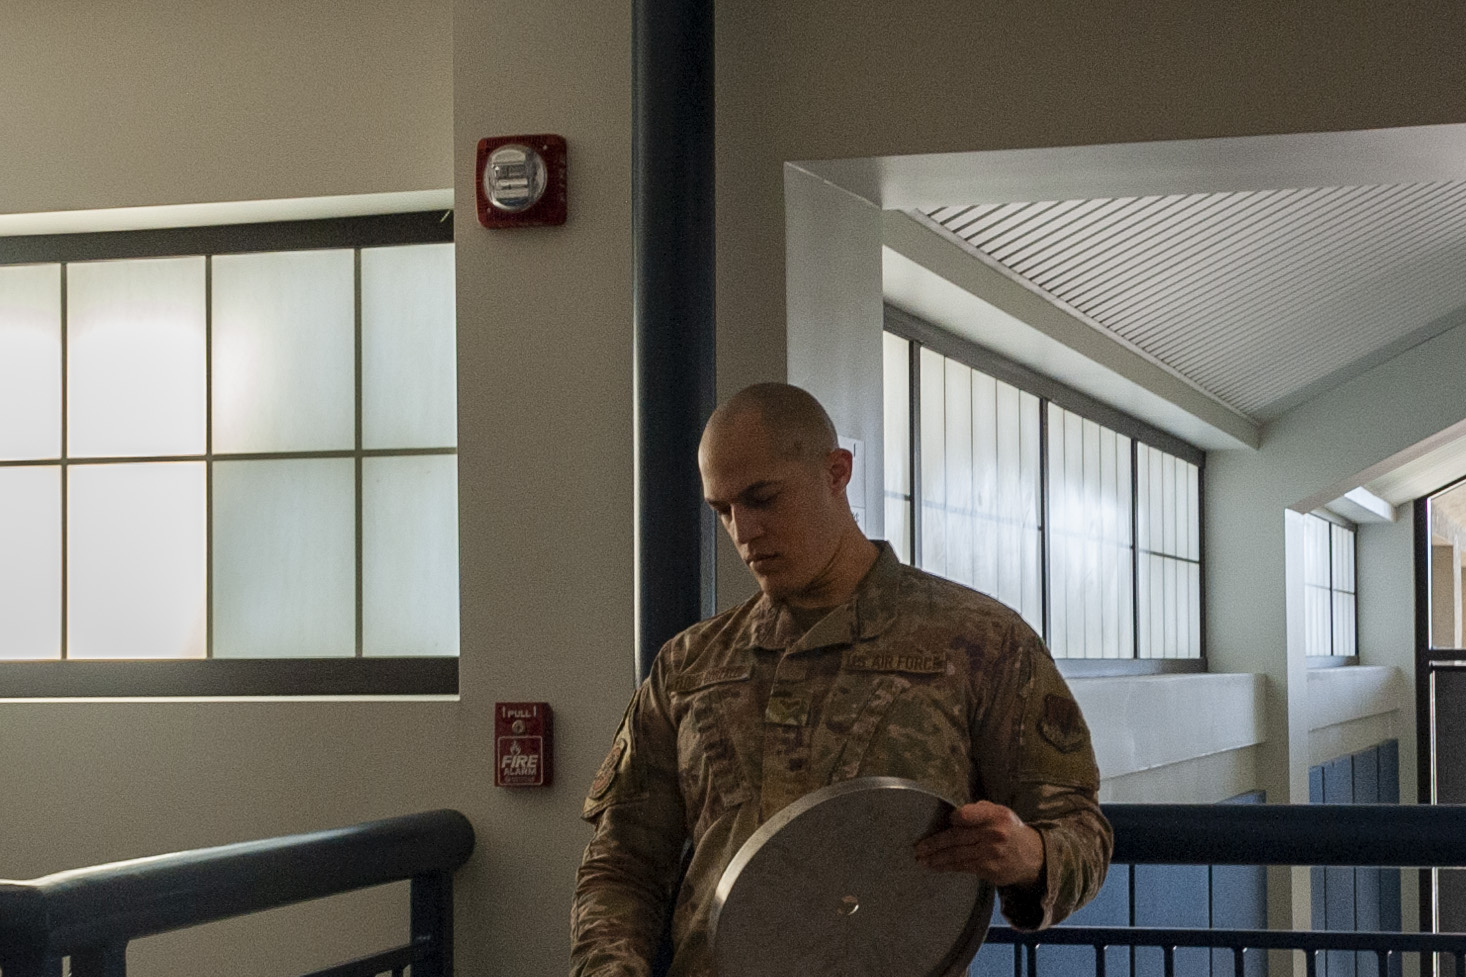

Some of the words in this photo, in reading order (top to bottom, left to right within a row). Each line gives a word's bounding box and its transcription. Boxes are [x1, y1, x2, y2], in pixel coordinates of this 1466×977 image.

[872, 654, 892, 669] AIR
[507, 709, 531, 718] PULL
[501, 754, 538, 769] FIRE
[503, 768, 537, 776] ALARM
